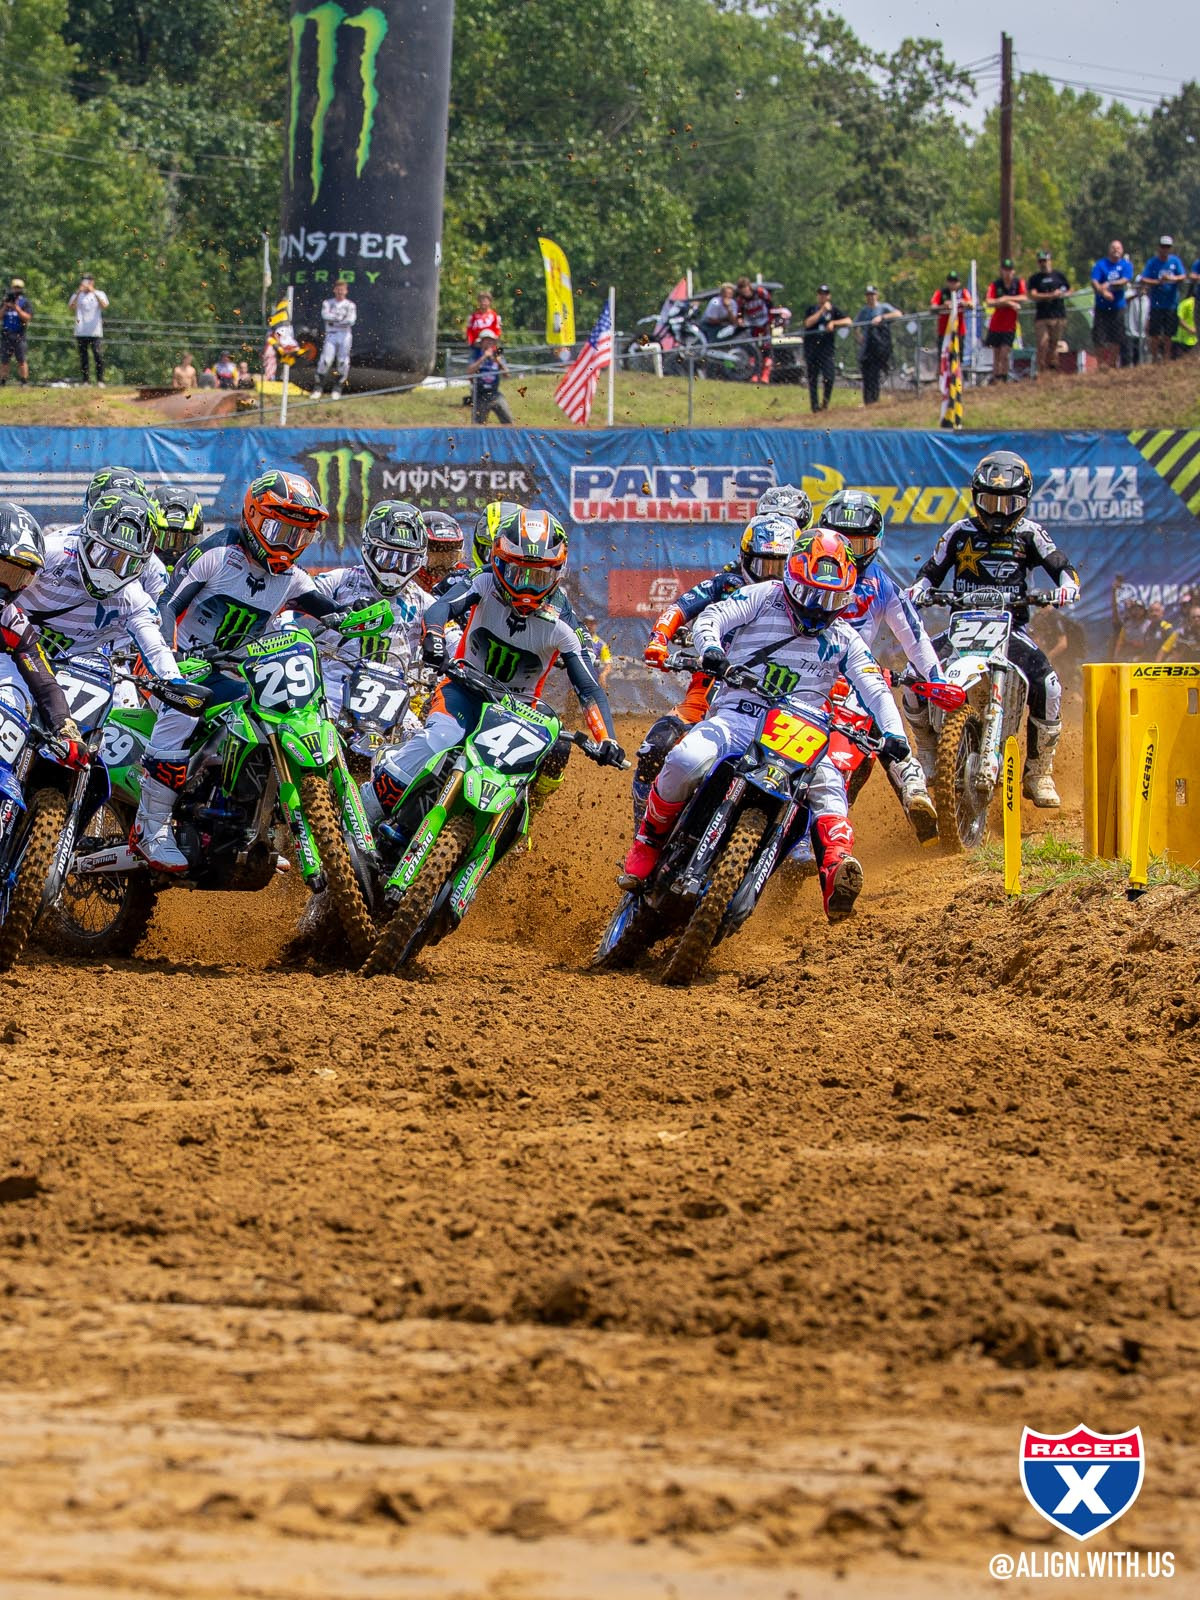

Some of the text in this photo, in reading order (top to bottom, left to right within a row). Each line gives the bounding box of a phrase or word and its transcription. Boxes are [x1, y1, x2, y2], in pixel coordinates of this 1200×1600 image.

[382, 465, 530, 493] MONSTER
[572, 466, 777, 499] PARTS
[1032, 466, 1140, 500] AMA
[573, 500, 758, 521] UNLIMITE
[1088, 500, 1144, 519] YEARS
[252, 638, 296, 654] RENTHAL
[433, 638, 442, 657] FOX
[955, 621, 1007, 648] 24
[255, 655, 316, 708] 29
[1133, 666, 1200, 677] ACERBIS
[350, 680, 408, 722] 31
[473, 721, 547, 766] 47
[760, 711, 828, 764] 38
[1006, 756, 1015, 812] ACERBIS
[1141, 743, 1154, 801] ACERBIS
[58, 820, 76, 874] DUNLOP
[294, 810, 316, 867] DUNLOP
[403, 832, 434, 883] DUNLOP
[697, 812, 724, 861] DUNLOP
[473, 856, 490, 885] BRAKING
[754, 841, 778, 893] DUNLOP
